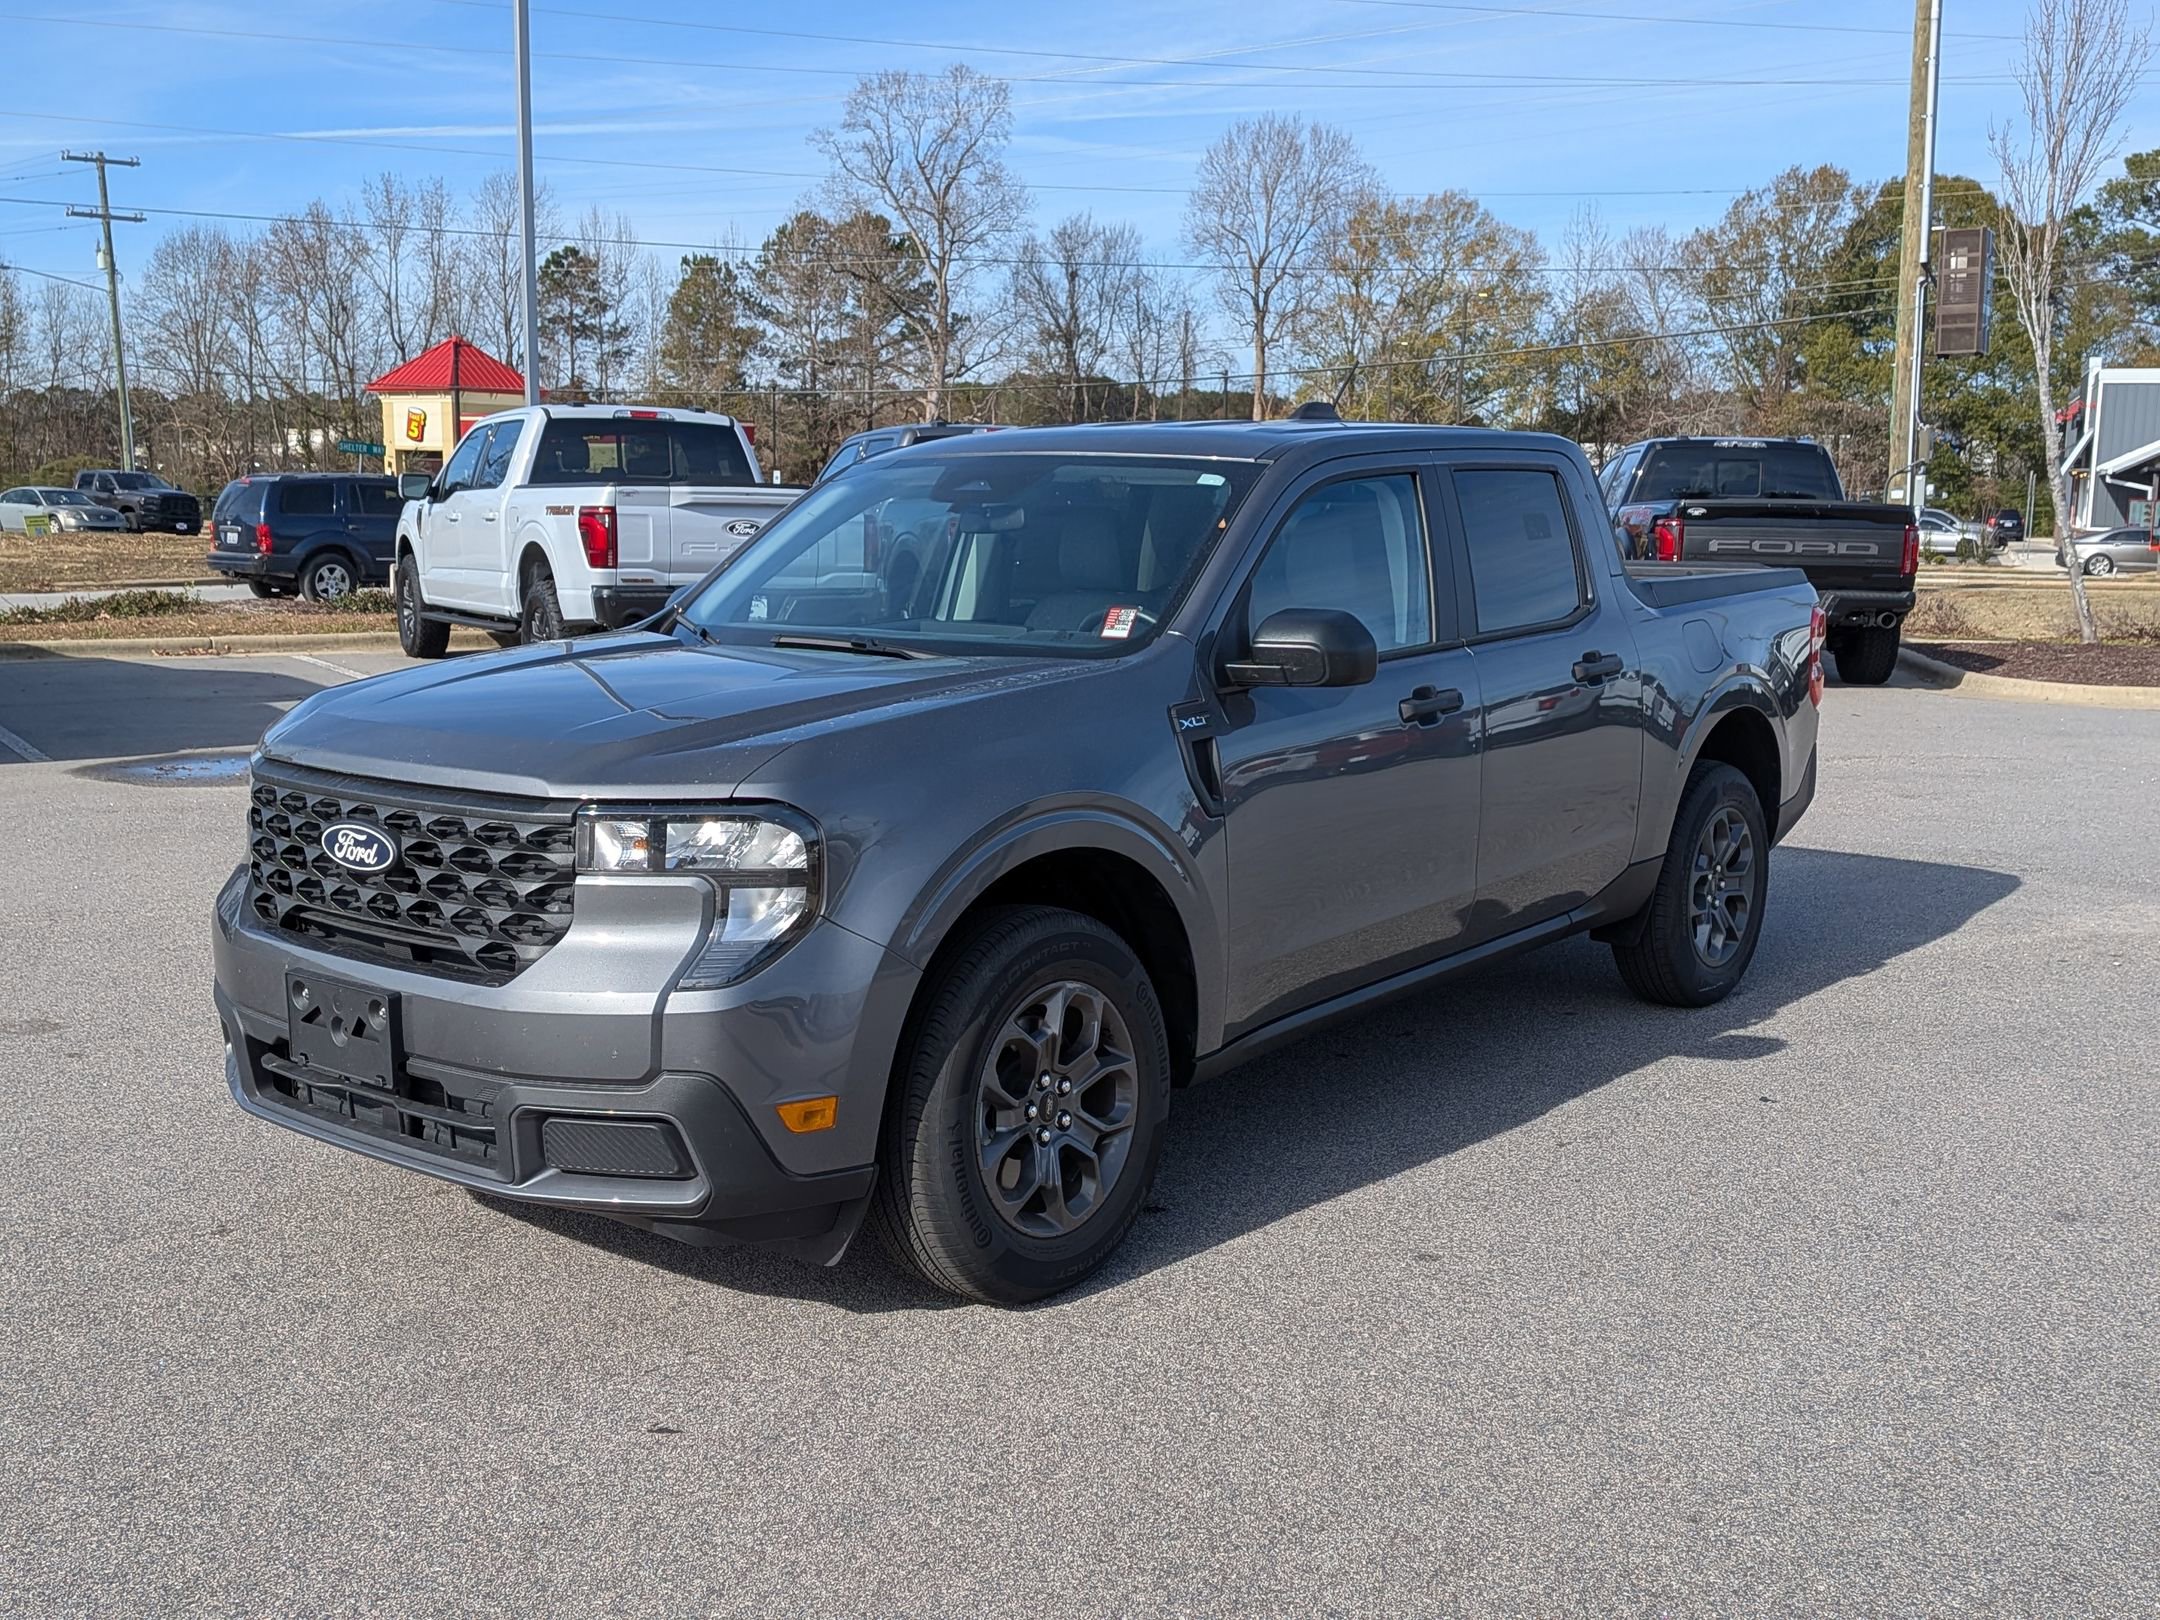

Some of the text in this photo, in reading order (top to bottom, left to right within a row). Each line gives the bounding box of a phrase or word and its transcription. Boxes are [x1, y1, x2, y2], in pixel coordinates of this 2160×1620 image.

[408, 420, 419, 438] 5
[340, 442, 385, 455] SHELTER WAY
[733, 523, 757, 535] Ford
[1708, 538, 1878, 555] FORD
[1179, 714, 1210, 730] XLT
[334, 829, 379, 865] Ford
